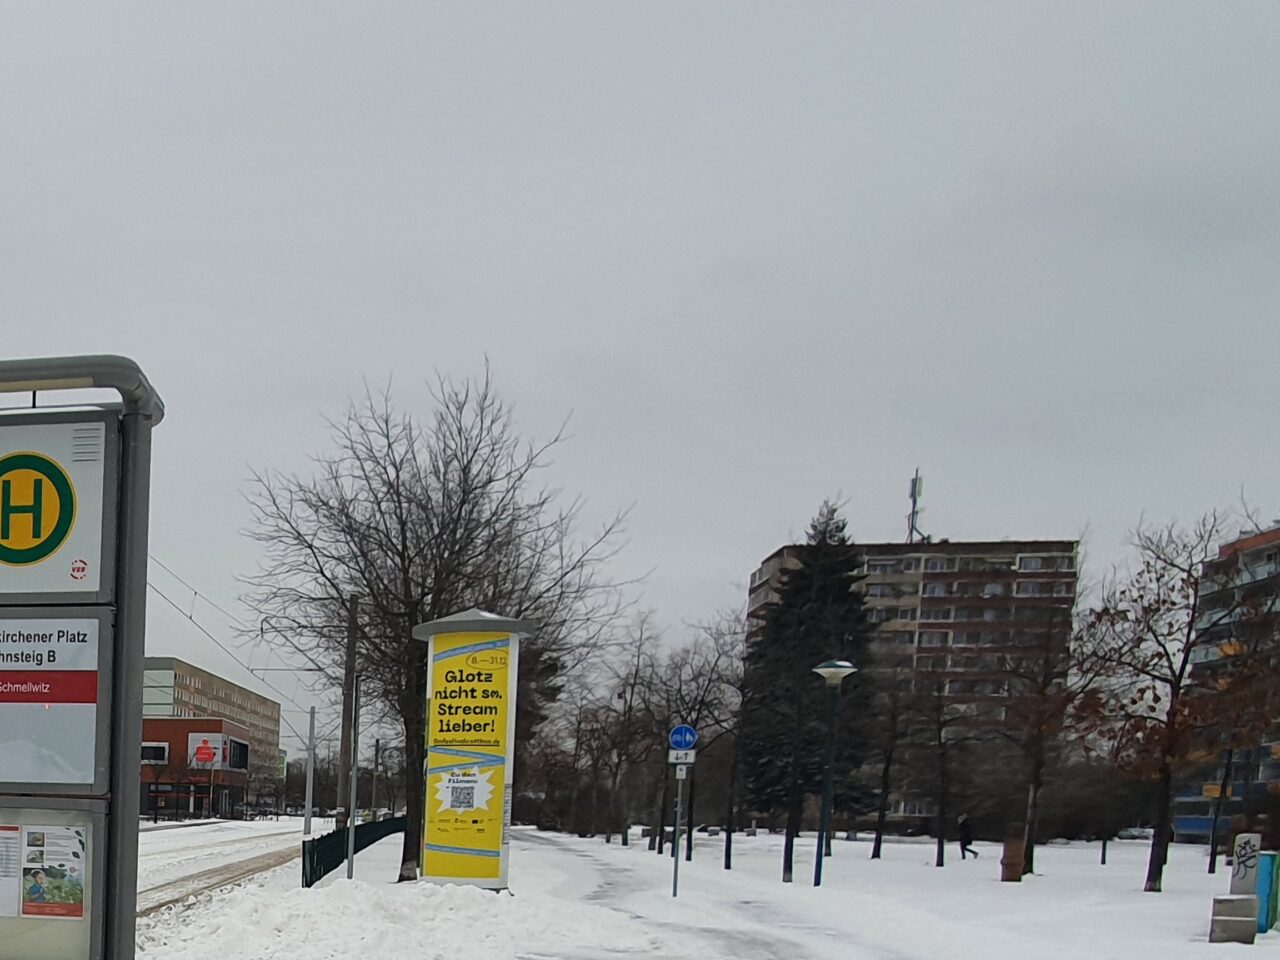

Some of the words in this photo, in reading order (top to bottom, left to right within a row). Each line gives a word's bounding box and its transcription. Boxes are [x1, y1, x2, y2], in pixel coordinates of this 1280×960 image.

[0, 478, 43, 540] H
[57, 630, 88, 643] Platz
[47, 650, 57, 663] B
[445, 670, 493, 683] Glotz
[435, 686, 477, 700] nicht
[438, 703, 498, 716] Stream
[438, 719, 495, 733] lieber!
